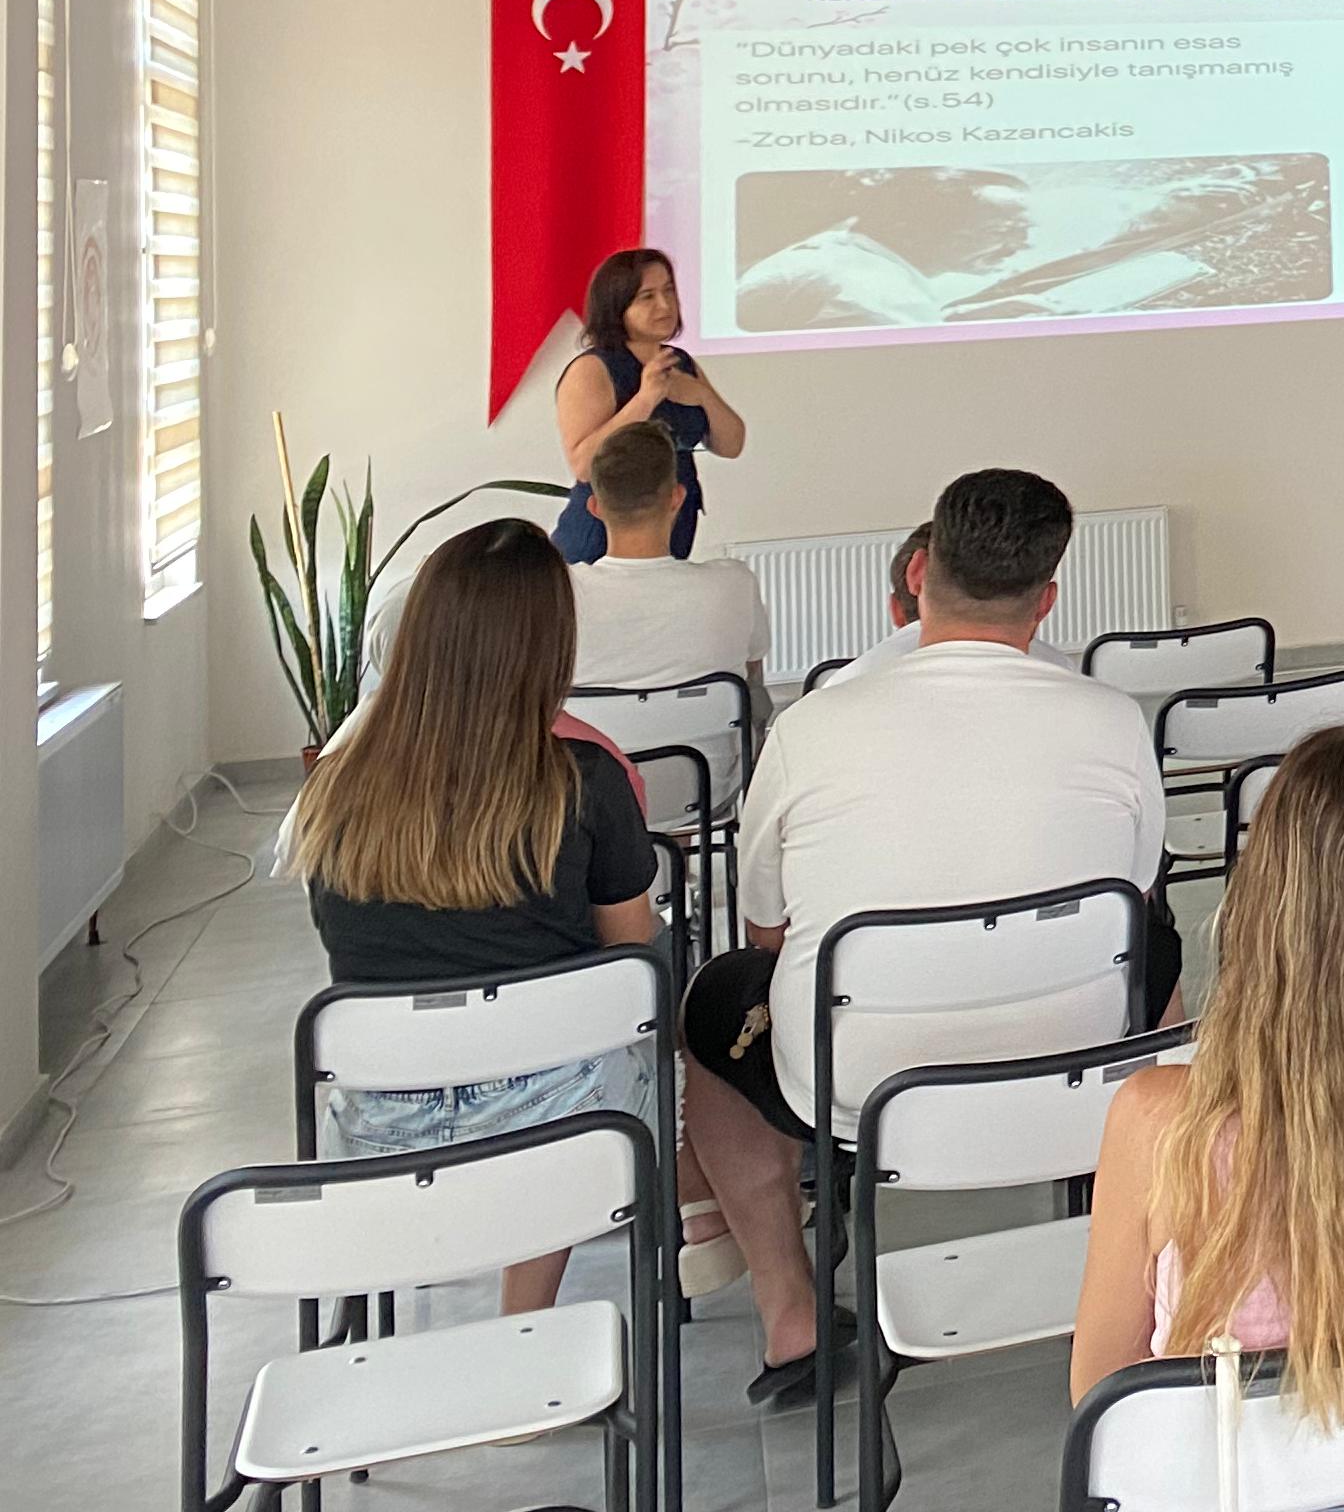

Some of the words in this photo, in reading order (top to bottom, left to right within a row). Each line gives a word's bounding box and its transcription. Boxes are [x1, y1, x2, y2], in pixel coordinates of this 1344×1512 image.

[930, 39, 987, 58] pek
[995, 38, 1051, 58] çok
[1059, 36, 1164, 52] insanın
[1173, 36, 1241, 50] esas
[735, 71, 855, 86] sorunu,
[864, 66, 960, 83] henüz
[969, 63, 1119, 82] kendisiyle
[1128, 61, 1294, 80] tanışmamış
[864, 128, 952, 145] Nikos
[962, 122, 1135, 142] Kazancakis
